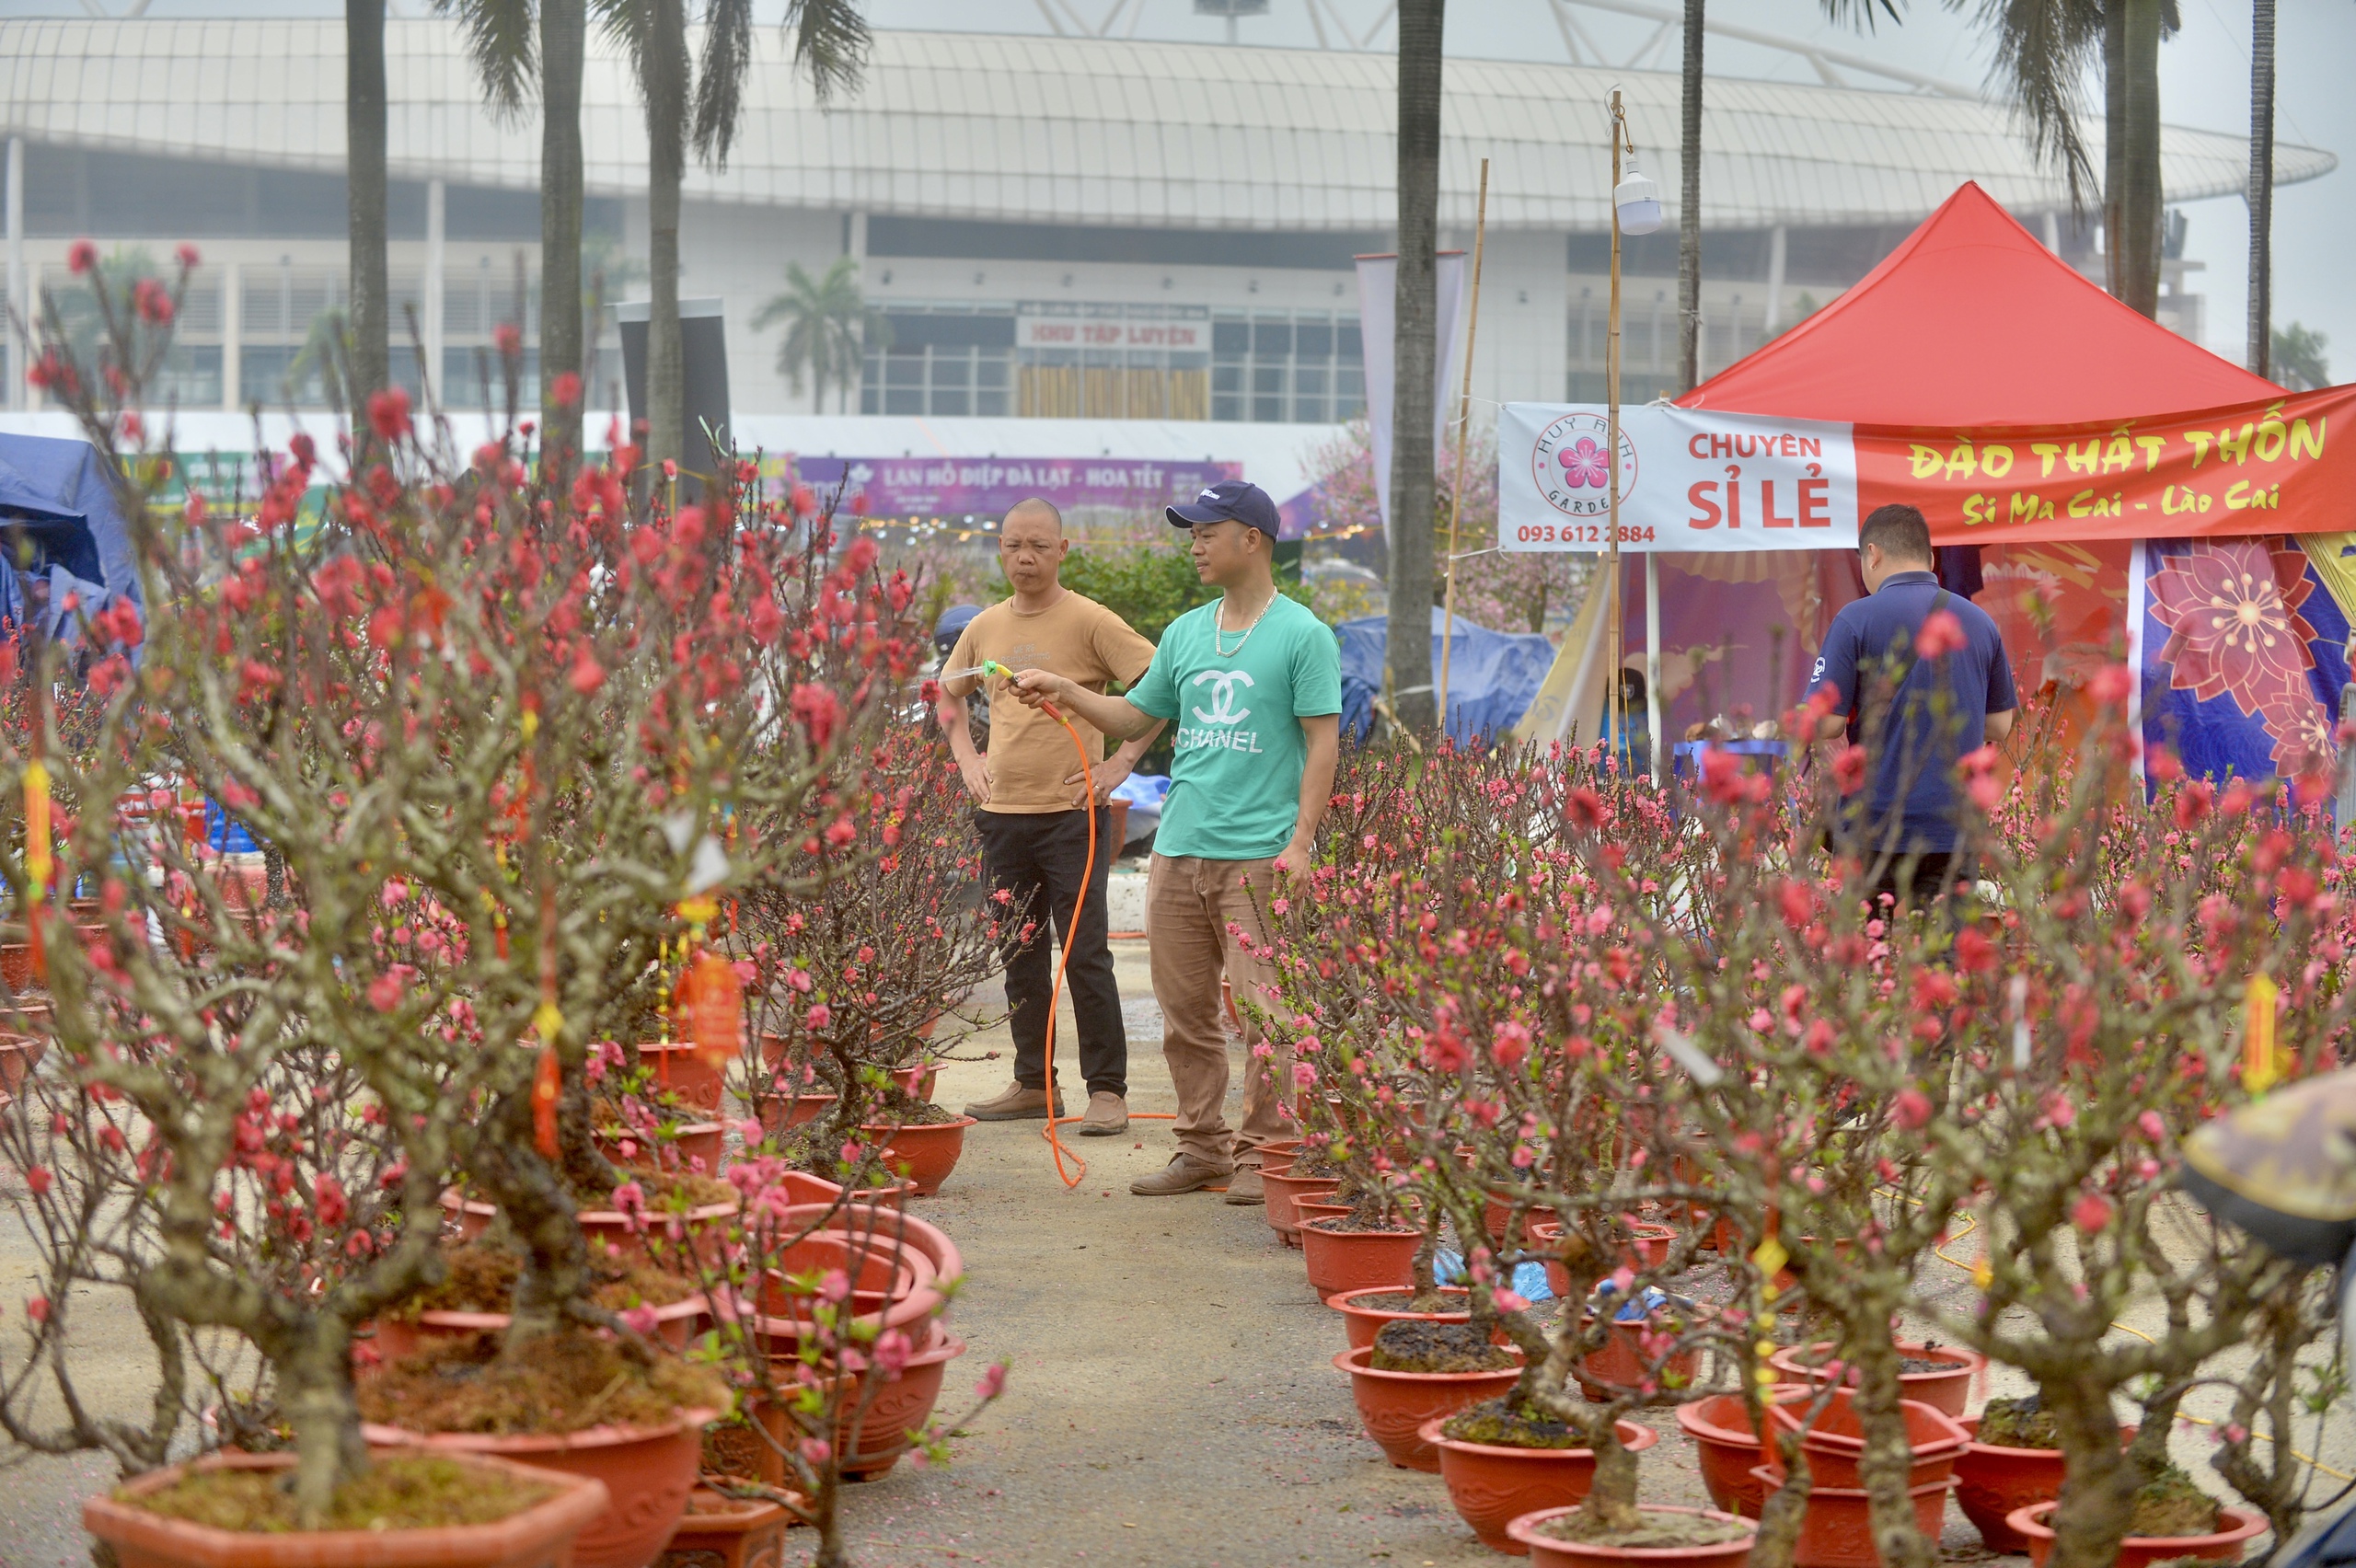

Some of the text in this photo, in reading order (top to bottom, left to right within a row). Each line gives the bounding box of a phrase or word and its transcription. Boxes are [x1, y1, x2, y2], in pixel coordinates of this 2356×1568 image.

[1538, 417, 1576, 454] HUY
[1689, 433, 1822, 459] CHUYÊN
[1907, 399, 2327, 481] ĐÀO THẤT THỐN
[1085, 468, 1129, 488] HOA
[1548, 490, 1621, 513] GARDE
[1688, 463, 1831, 530] SỈ LẺ
[2009, 491, 2055, 525] Ma
[2068, 489, 2122, 518] Cai
[2161, 484, 2212, 515] Lào
[2224, 479, 2281, 510] Cai
[1518, 525, 1555, 542] 093
[1561, 525, 1599, 542] 612
[1178, 727, 1264, 754] CHANEL
